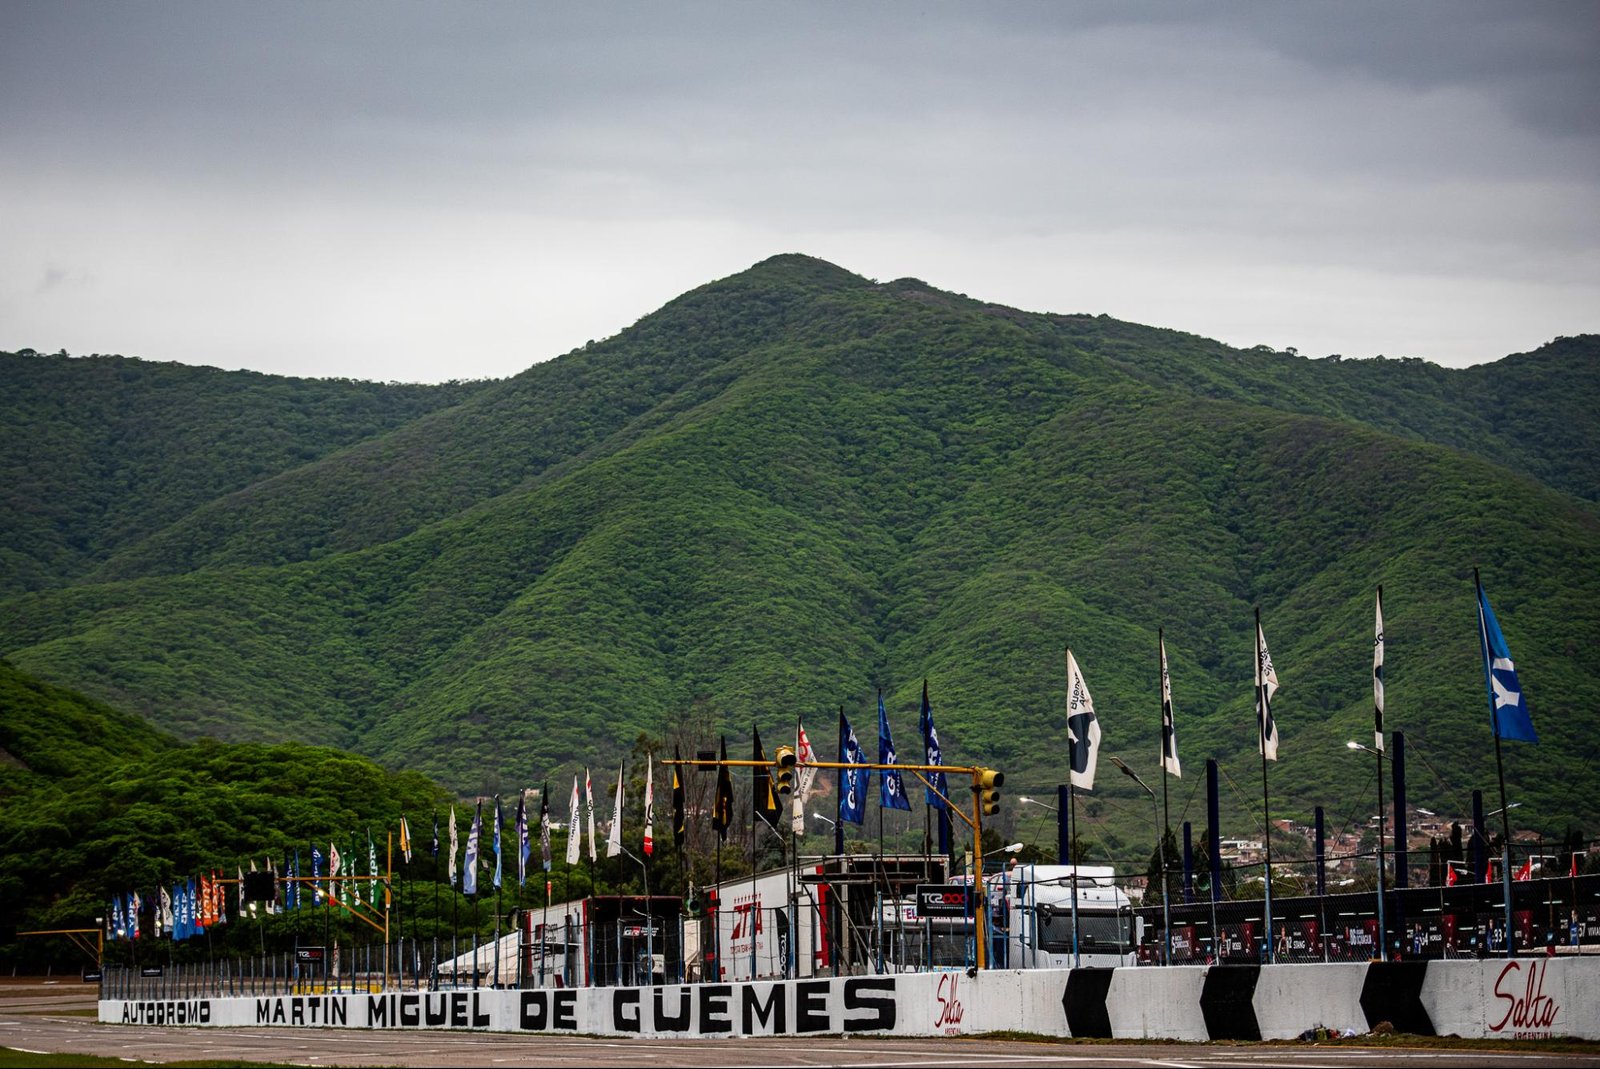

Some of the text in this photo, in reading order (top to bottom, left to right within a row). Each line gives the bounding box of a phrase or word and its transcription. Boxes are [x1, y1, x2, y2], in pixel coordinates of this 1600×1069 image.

[122, 978, 897, 1035] AUTODROMO MARTIN MIGUEL DE GÜEMES
[934, 973, 964, 1028] Salta
[1488, 960, 1560, 1032] Salta
